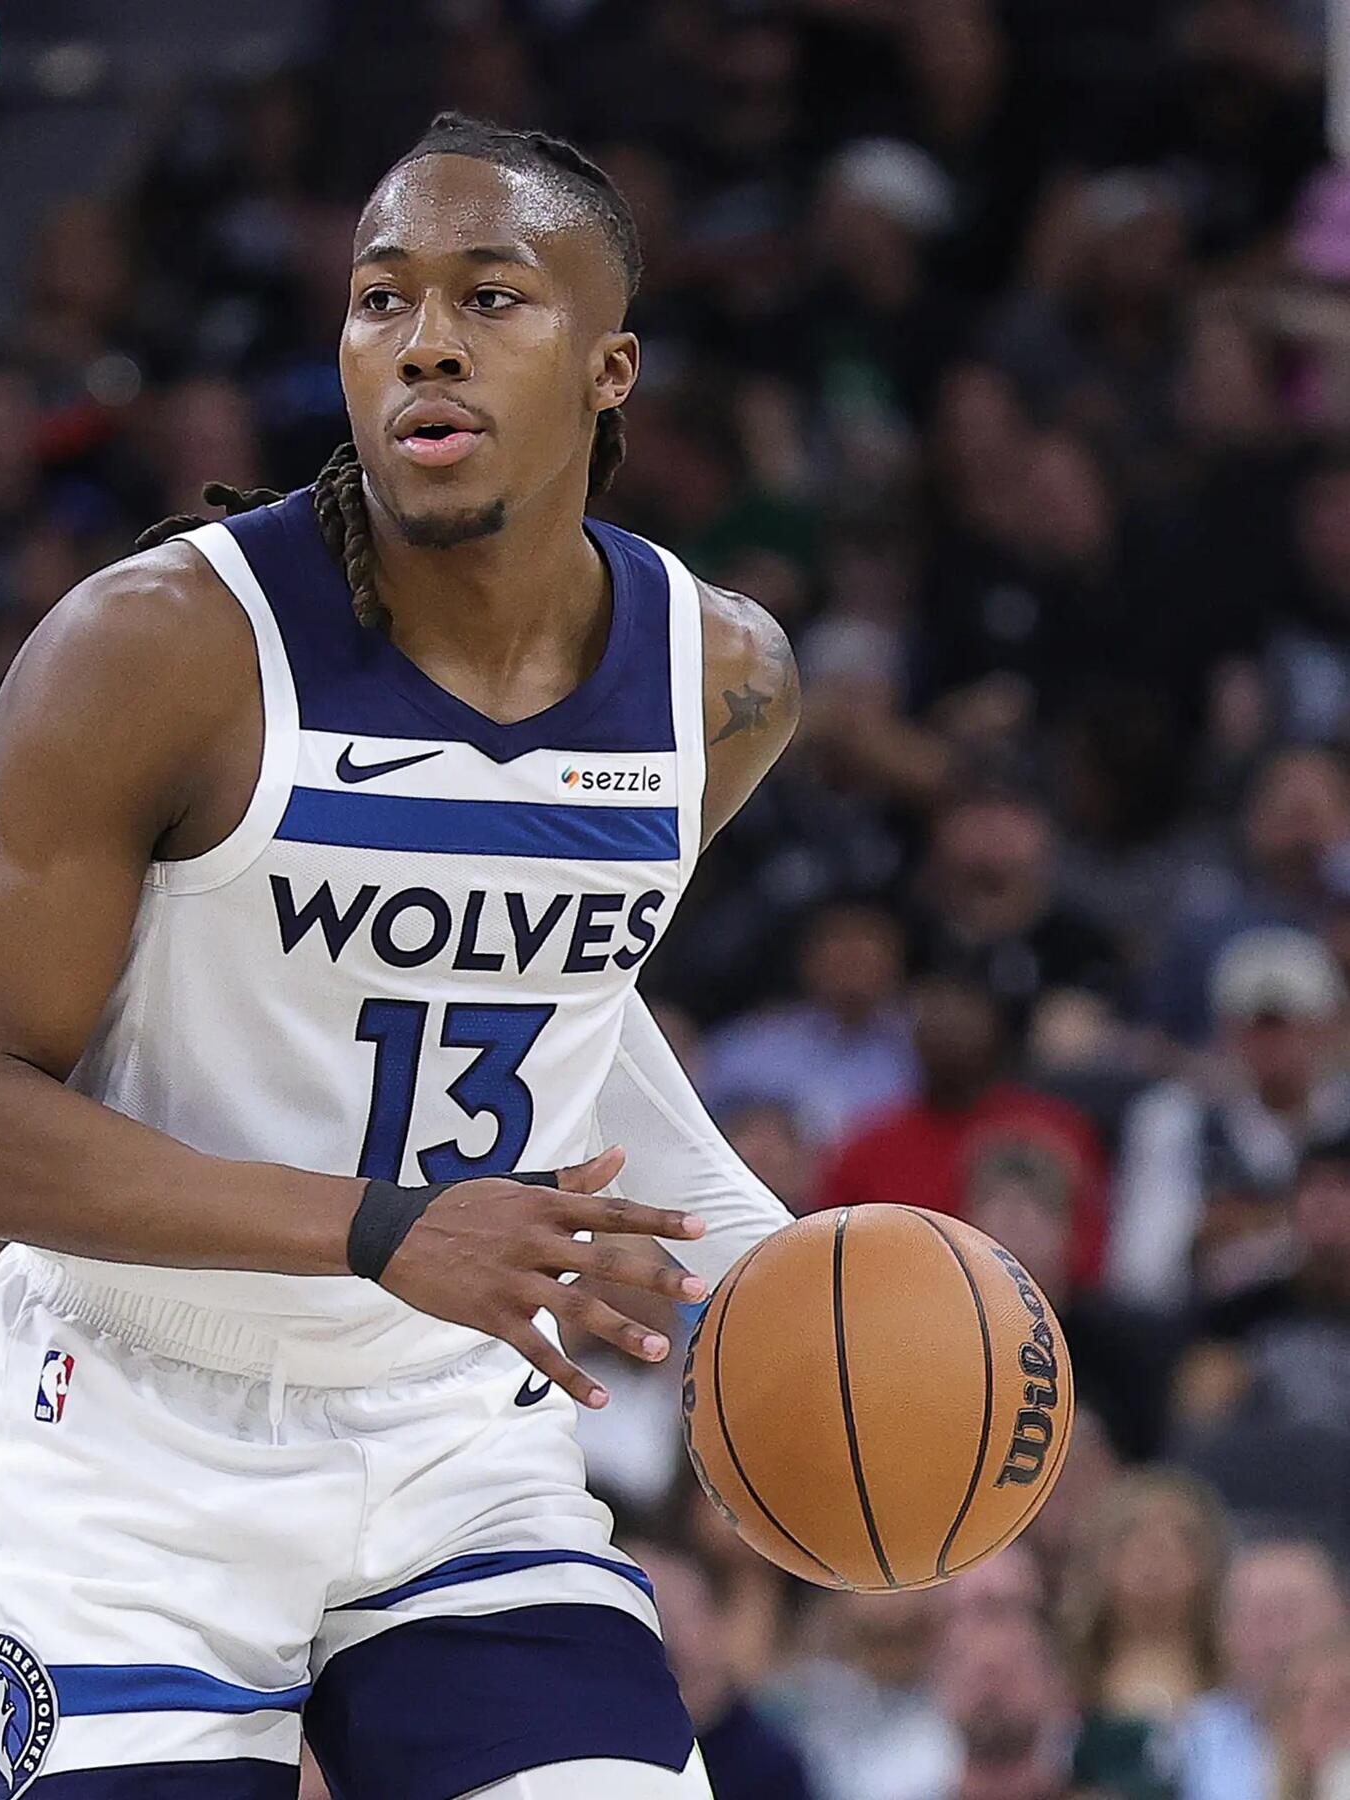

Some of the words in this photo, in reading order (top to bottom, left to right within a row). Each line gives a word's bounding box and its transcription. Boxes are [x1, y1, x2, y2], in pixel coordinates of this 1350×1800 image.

[581, 765, 661, 792] sezzle
[269, 874, 666, 974] WOLVES
[355, 998, 557, 1187] 13
